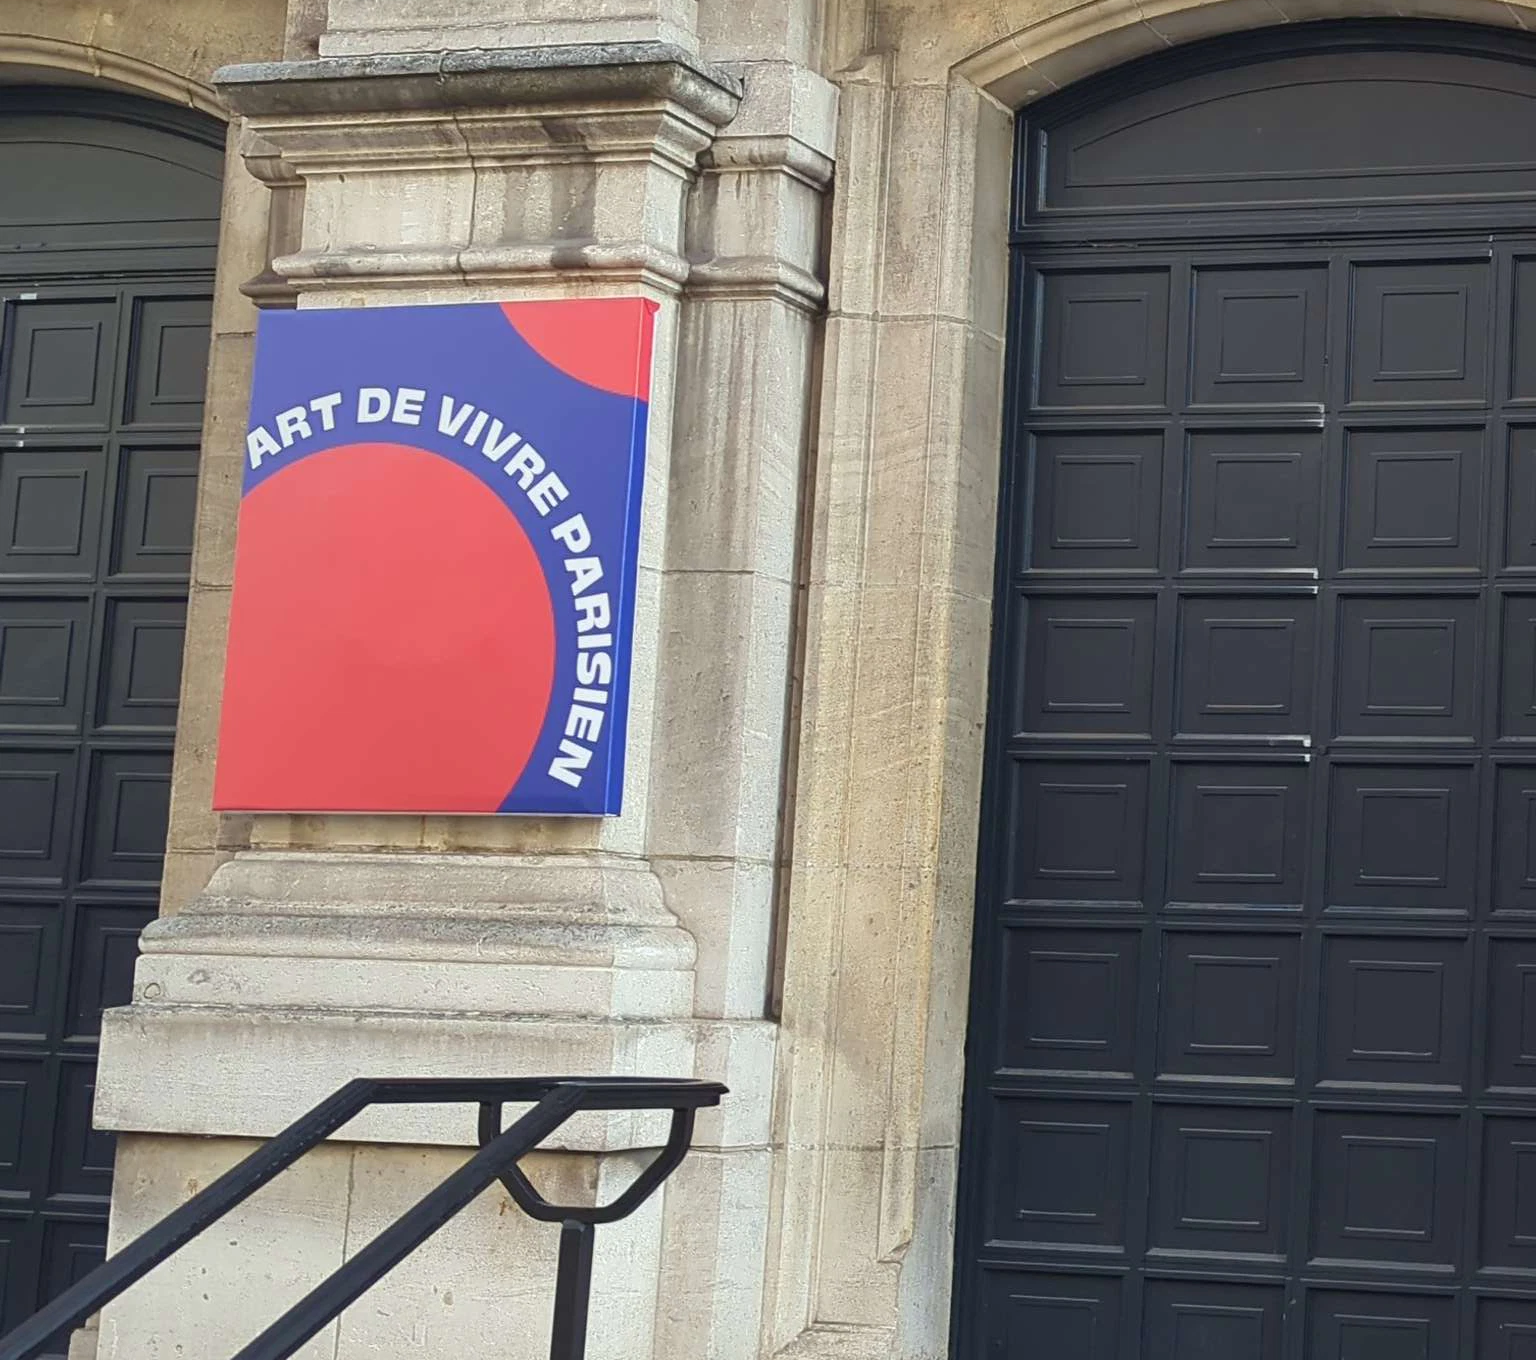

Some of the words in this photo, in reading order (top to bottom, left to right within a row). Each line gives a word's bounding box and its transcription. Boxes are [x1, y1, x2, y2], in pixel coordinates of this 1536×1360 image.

[245, 392, 343, 471] ART
[356, 387, 427, 425] DE
[437, 395, 570, 518] VIVRE
[547, 512, 613, 789] PARISIEN
